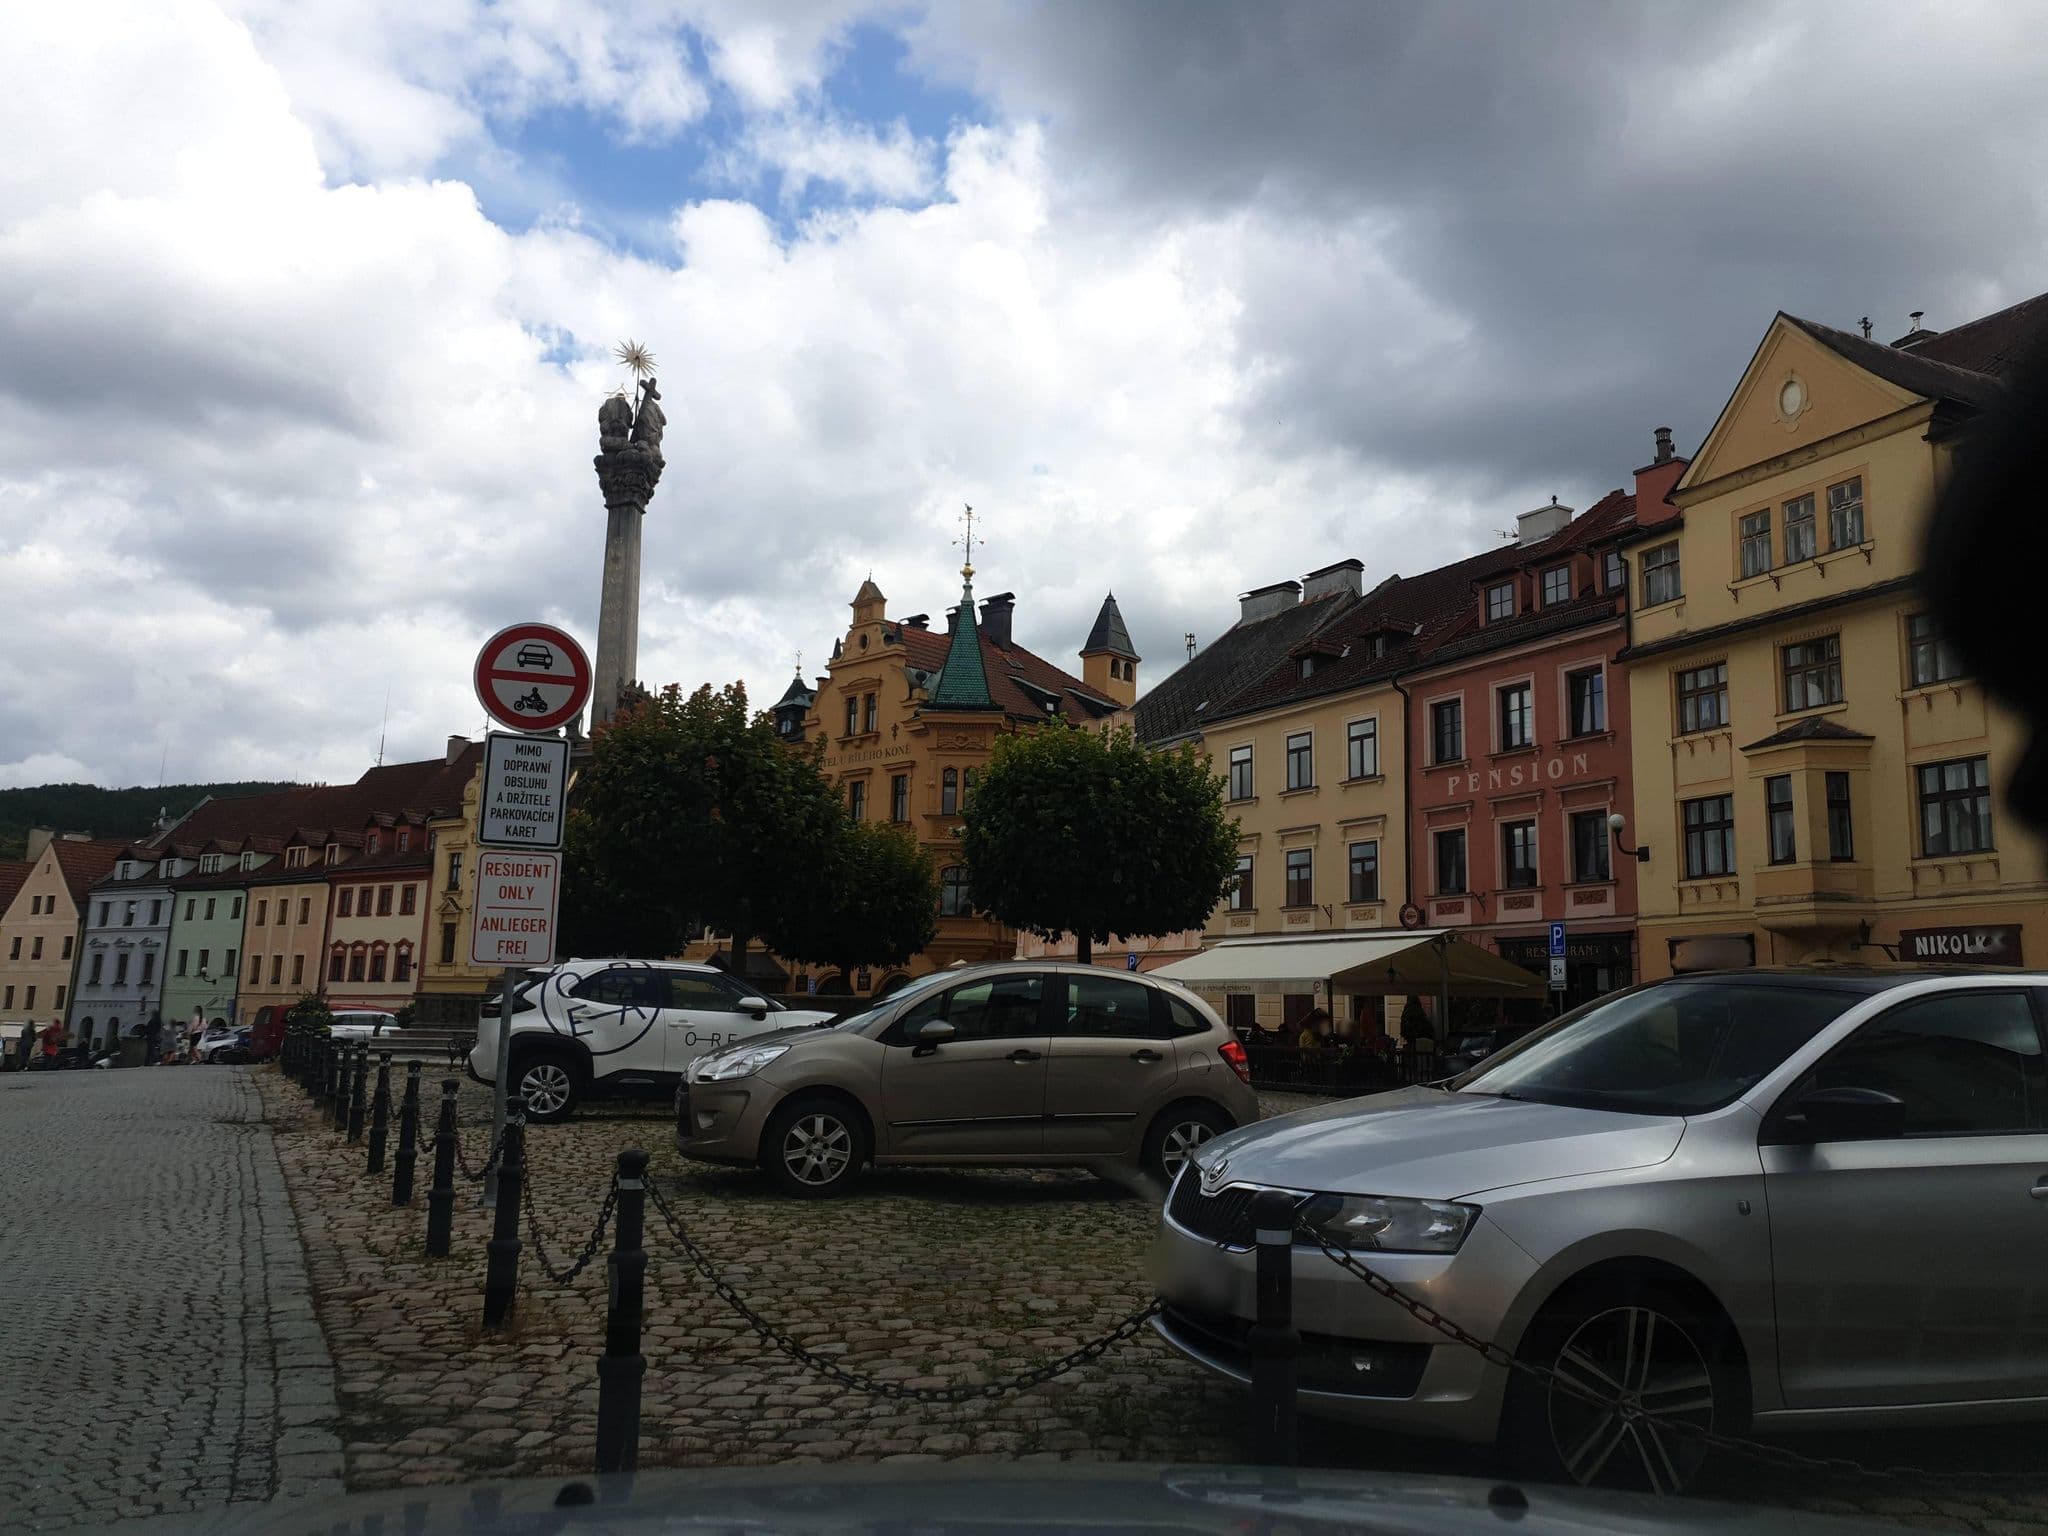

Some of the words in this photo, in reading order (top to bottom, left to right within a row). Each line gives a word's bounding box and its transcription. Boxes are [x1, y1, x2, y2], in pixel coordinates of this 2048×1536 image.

[515, 744, 542, 756] MIMO
[504, 759, 552, 774] DOPRAVNÍ
[1448, 753, 1588, 795] PENSION
[504, 776, 547, 789] OBSLUHU
[496, 792, 503, 803] A
[507, 791, 551, 806] DRŽITELE
[490, 807, 554, 823] PARKOVACÍCH
[505, 825, 537, 838] KARET
[485, 862, 551, 878] RESIDENT
[499, 885, 534, 900] ONLY
[480, 917, 547, 933] ANLIEGER
[1553, 926, 1562, 946] P
[497, 940, 527, 955] FREI
